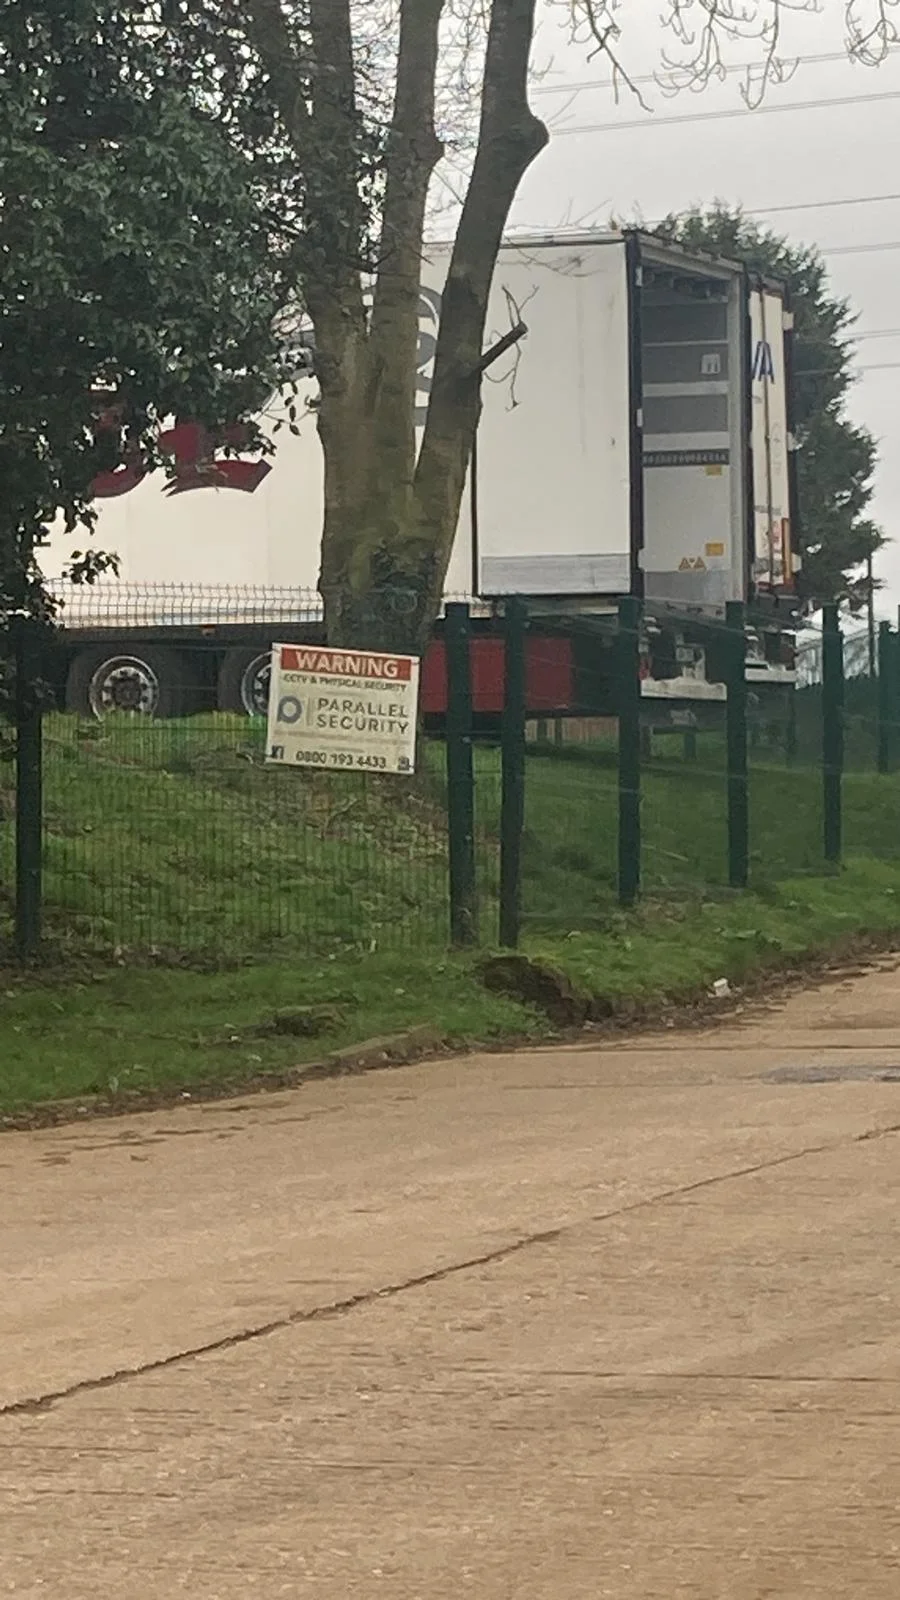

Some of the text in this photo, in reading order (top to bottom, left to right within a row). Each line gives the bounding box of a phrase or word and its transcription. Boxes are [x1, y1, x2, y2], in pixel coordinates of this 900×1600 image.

[295, 651, 399, 677] WARNING
[283, 674, 307, 684] CCTV
[319, 677, 361, 688] PHYSICAL
[364, 681, 407, 692] SECURITY
[317, 698, 409, 718] PARALLEL
[316, 714, 410, 734] SECURITY
[295, 751, 327, 764] 0800
[356, 755, 387, 768] 4433
